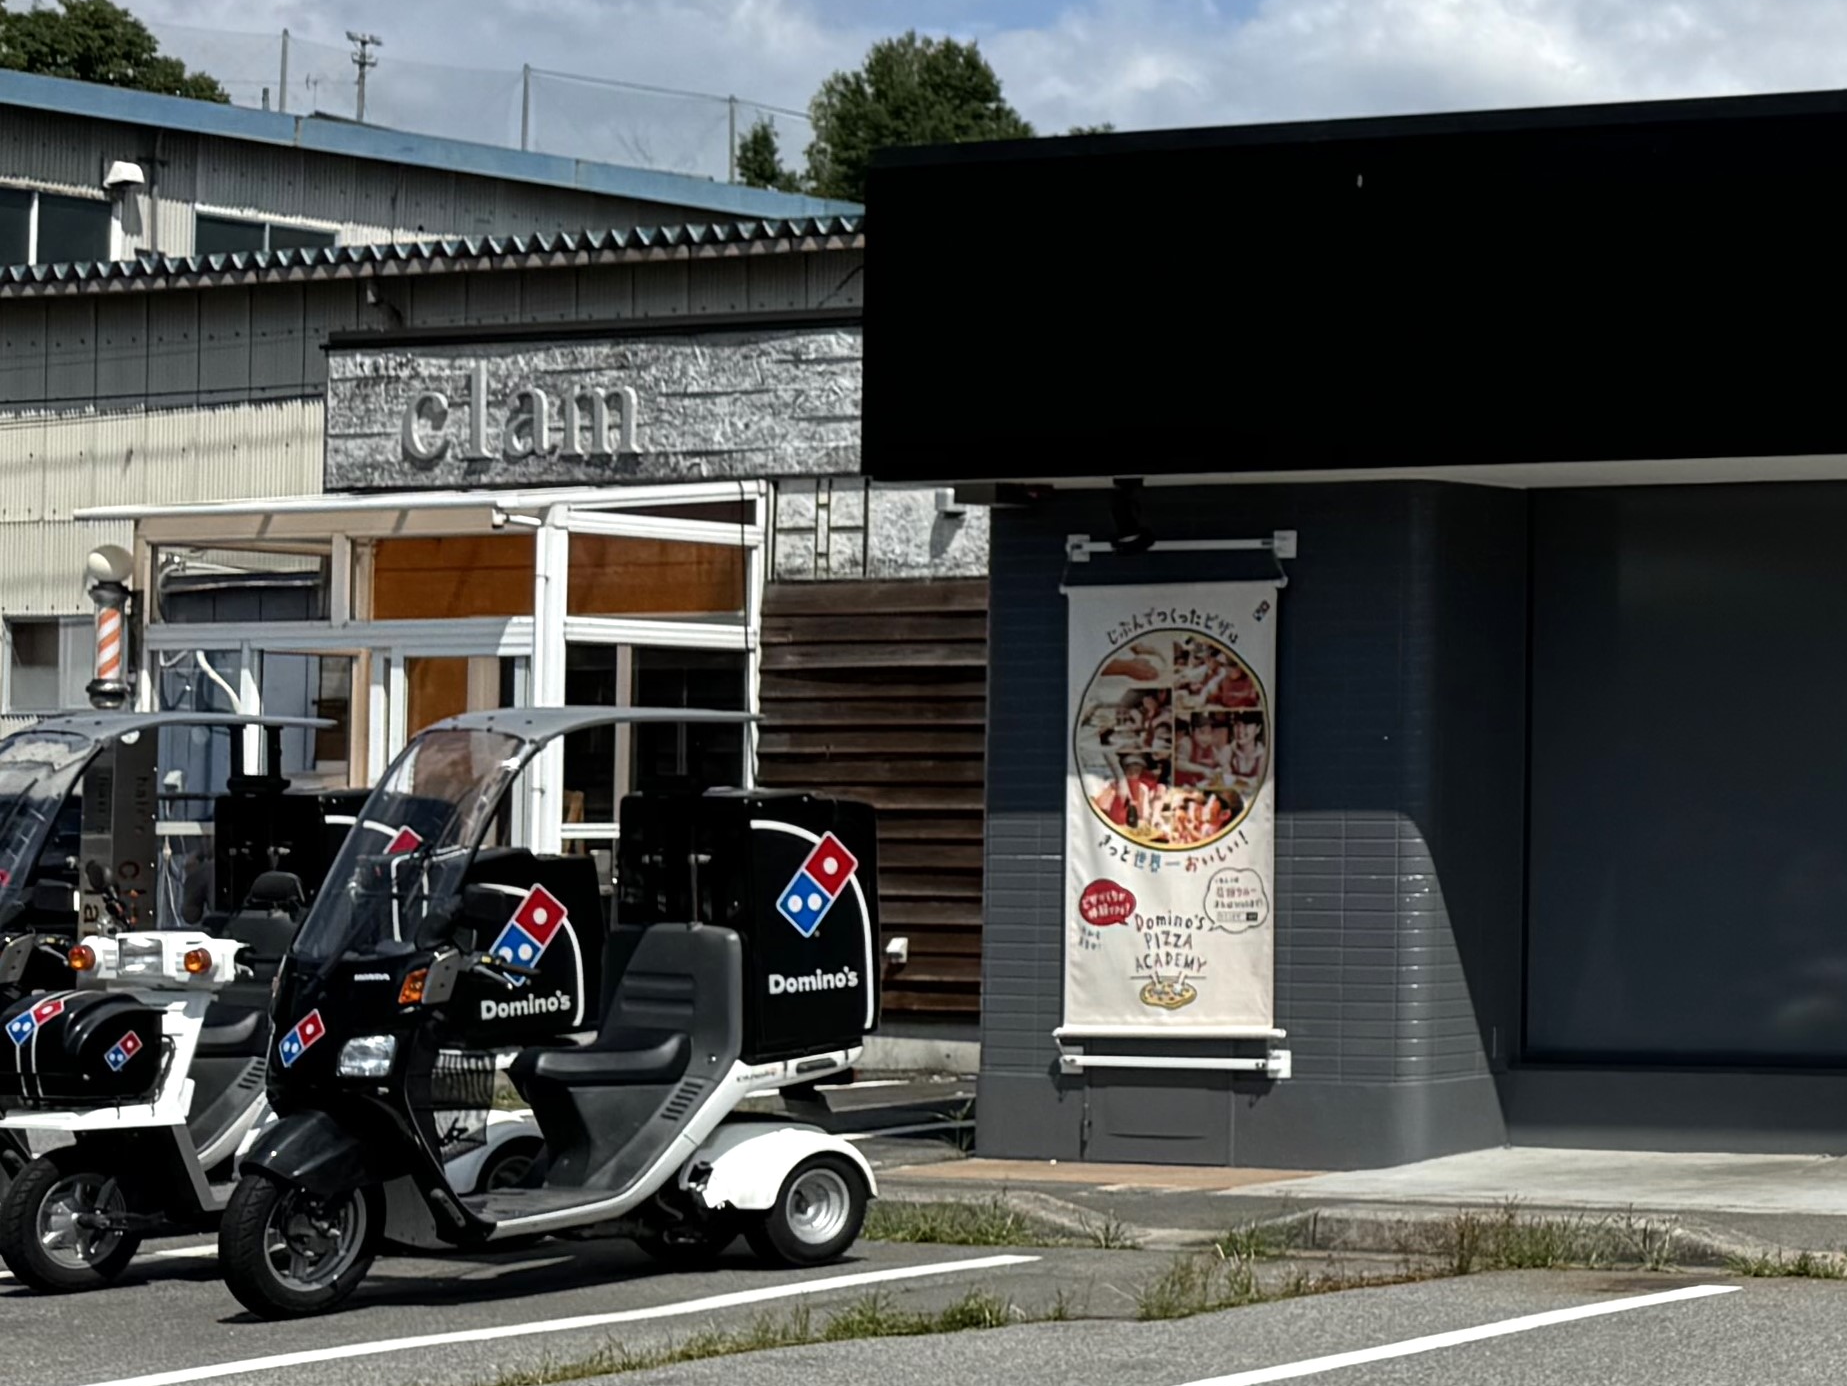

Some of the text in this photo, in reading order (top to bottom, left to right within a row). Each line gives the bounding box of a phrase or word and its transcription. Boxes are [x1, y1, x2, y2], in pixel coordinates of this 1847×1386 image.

[402, 360, 642, 461] clam
[1134, 911, 1205, 932] Domino's
[1144, 930, 1193, 950] PIZZA
[1135, 953, 1207, 973] ACADEMY
[768, 967, 859, 995] Domino's
[480, 991, 572, 1021] Domino's
